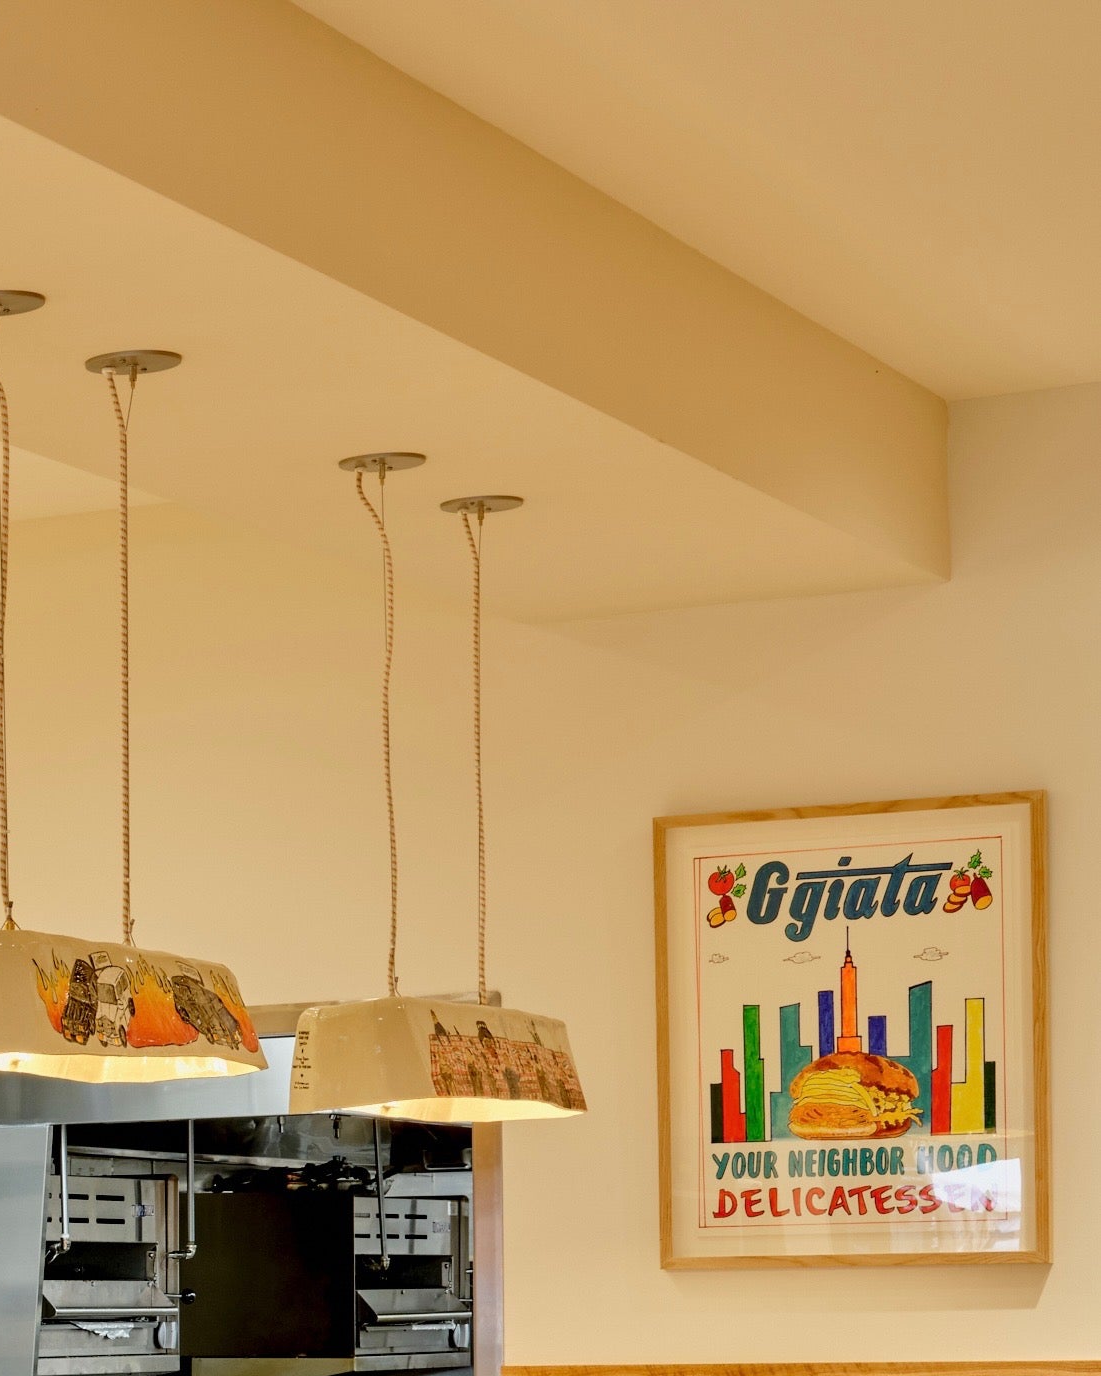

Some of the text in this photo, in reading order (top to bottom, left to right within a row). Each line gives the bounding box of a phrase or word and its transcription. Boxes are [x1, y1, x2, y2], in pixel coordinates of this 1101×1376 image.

[745, 852, 954, 943] Ggiata
[712, 1143, 998, 1180] YOUR NEIGHBOR HOOD
[712, 1184, 999, 1219] DELICATESSEN
